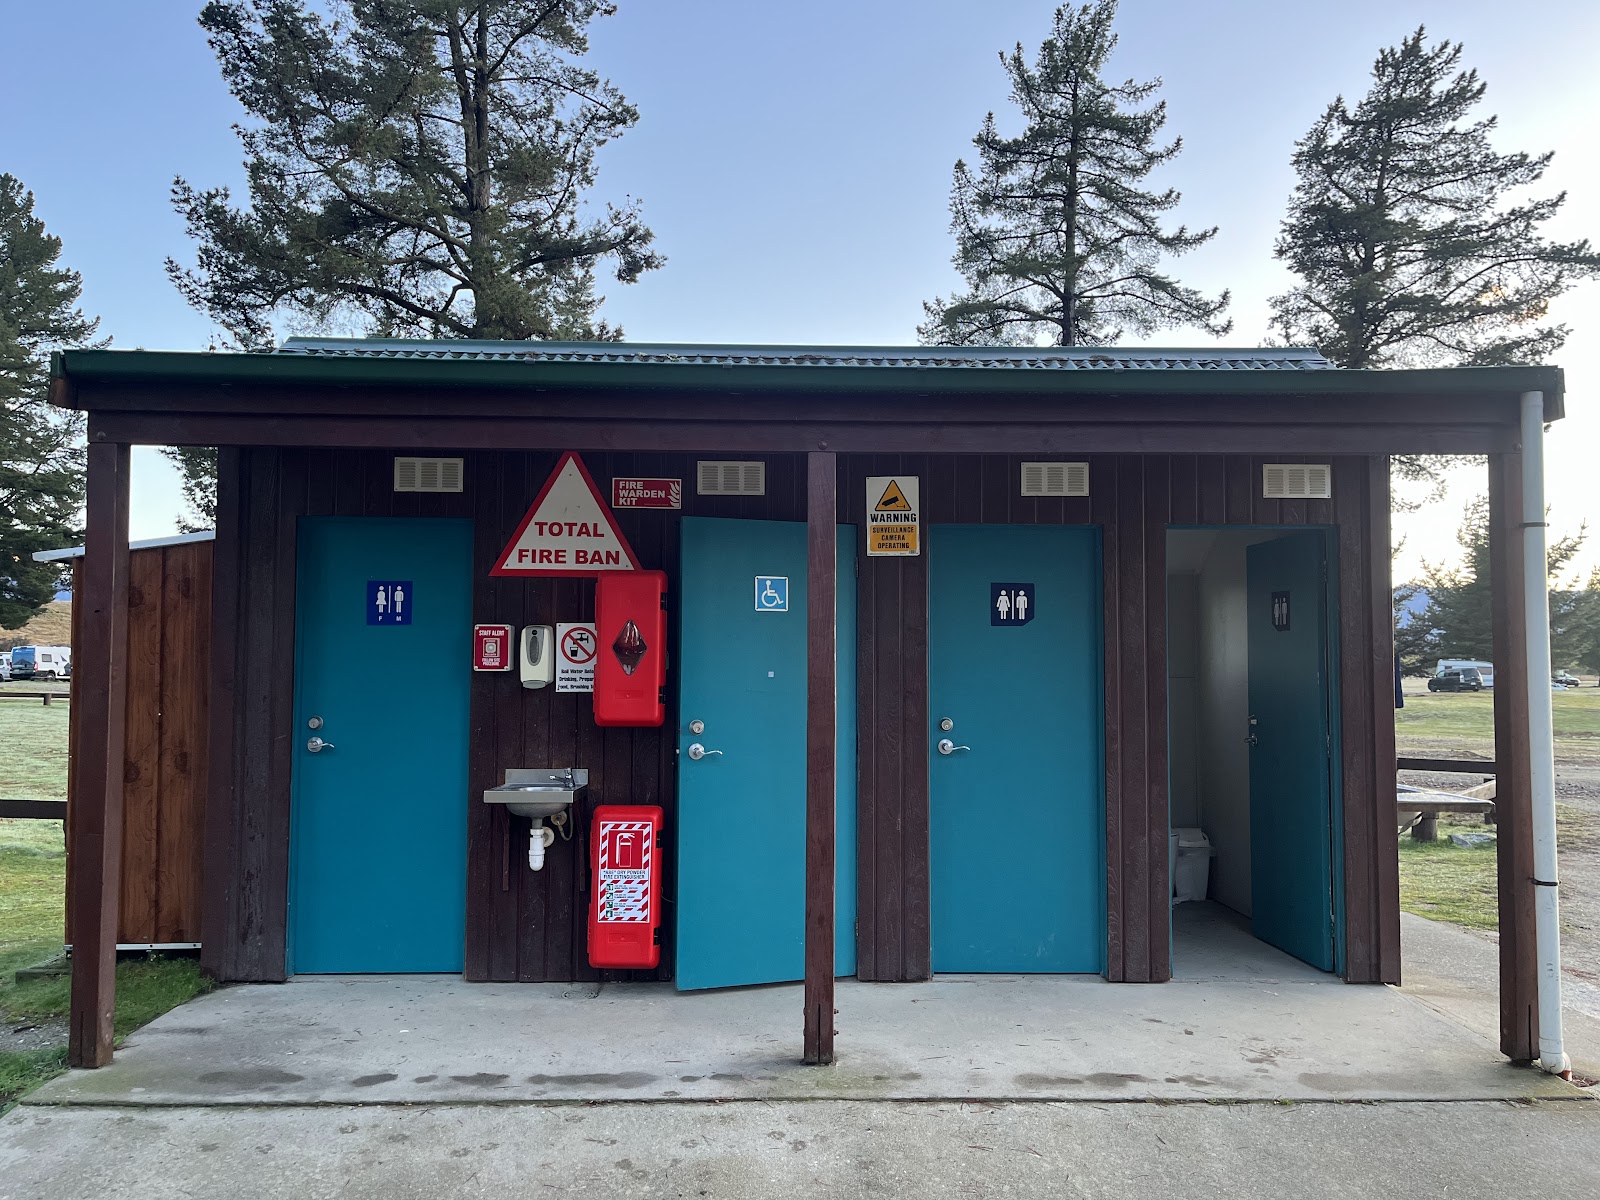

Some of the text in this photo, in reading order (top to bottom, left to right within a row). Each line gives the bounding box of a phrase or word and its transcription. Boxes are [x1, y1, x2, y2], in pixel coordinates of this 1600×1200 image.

[619, 481, 644, 490] FIRE
[619, 490, 666, 498] WARDEN
[619, 498, 638, 506] KIT
[870, 513, 916, 523] WARNING
[534, 522, 604, 538] TOTAL
[518, 548, 620, 565] FIRE BAN
